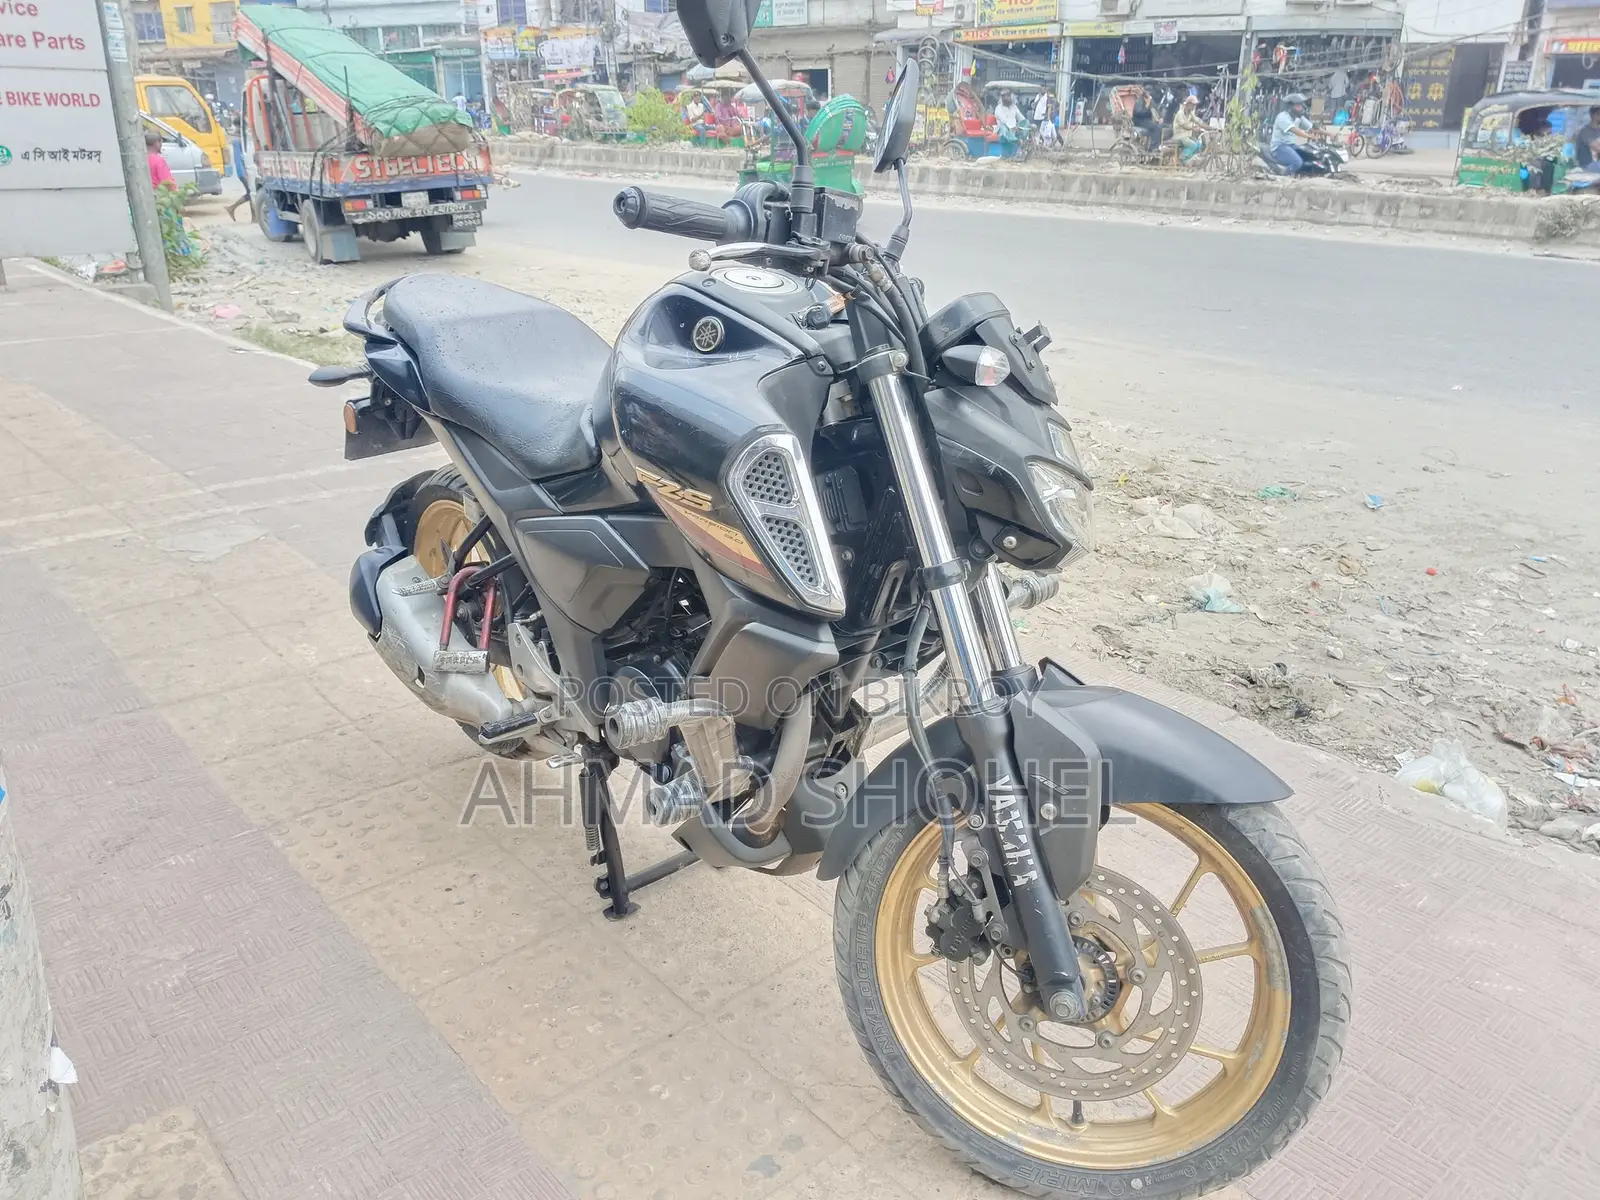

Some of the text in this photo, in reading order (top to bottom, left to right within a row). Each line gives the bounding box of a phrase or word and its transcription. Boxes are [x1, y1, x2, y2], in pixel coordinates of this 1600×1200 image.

[32, 31, 86, 50] Parts
[5, 91, 101, 107] BIKE WORLD
[21, 148, 30, 161] এ
[33, 147, 46, 161] সি
[47, 147, 70, 162] আই
[1012, 1163, 1100, 1196] MRF
